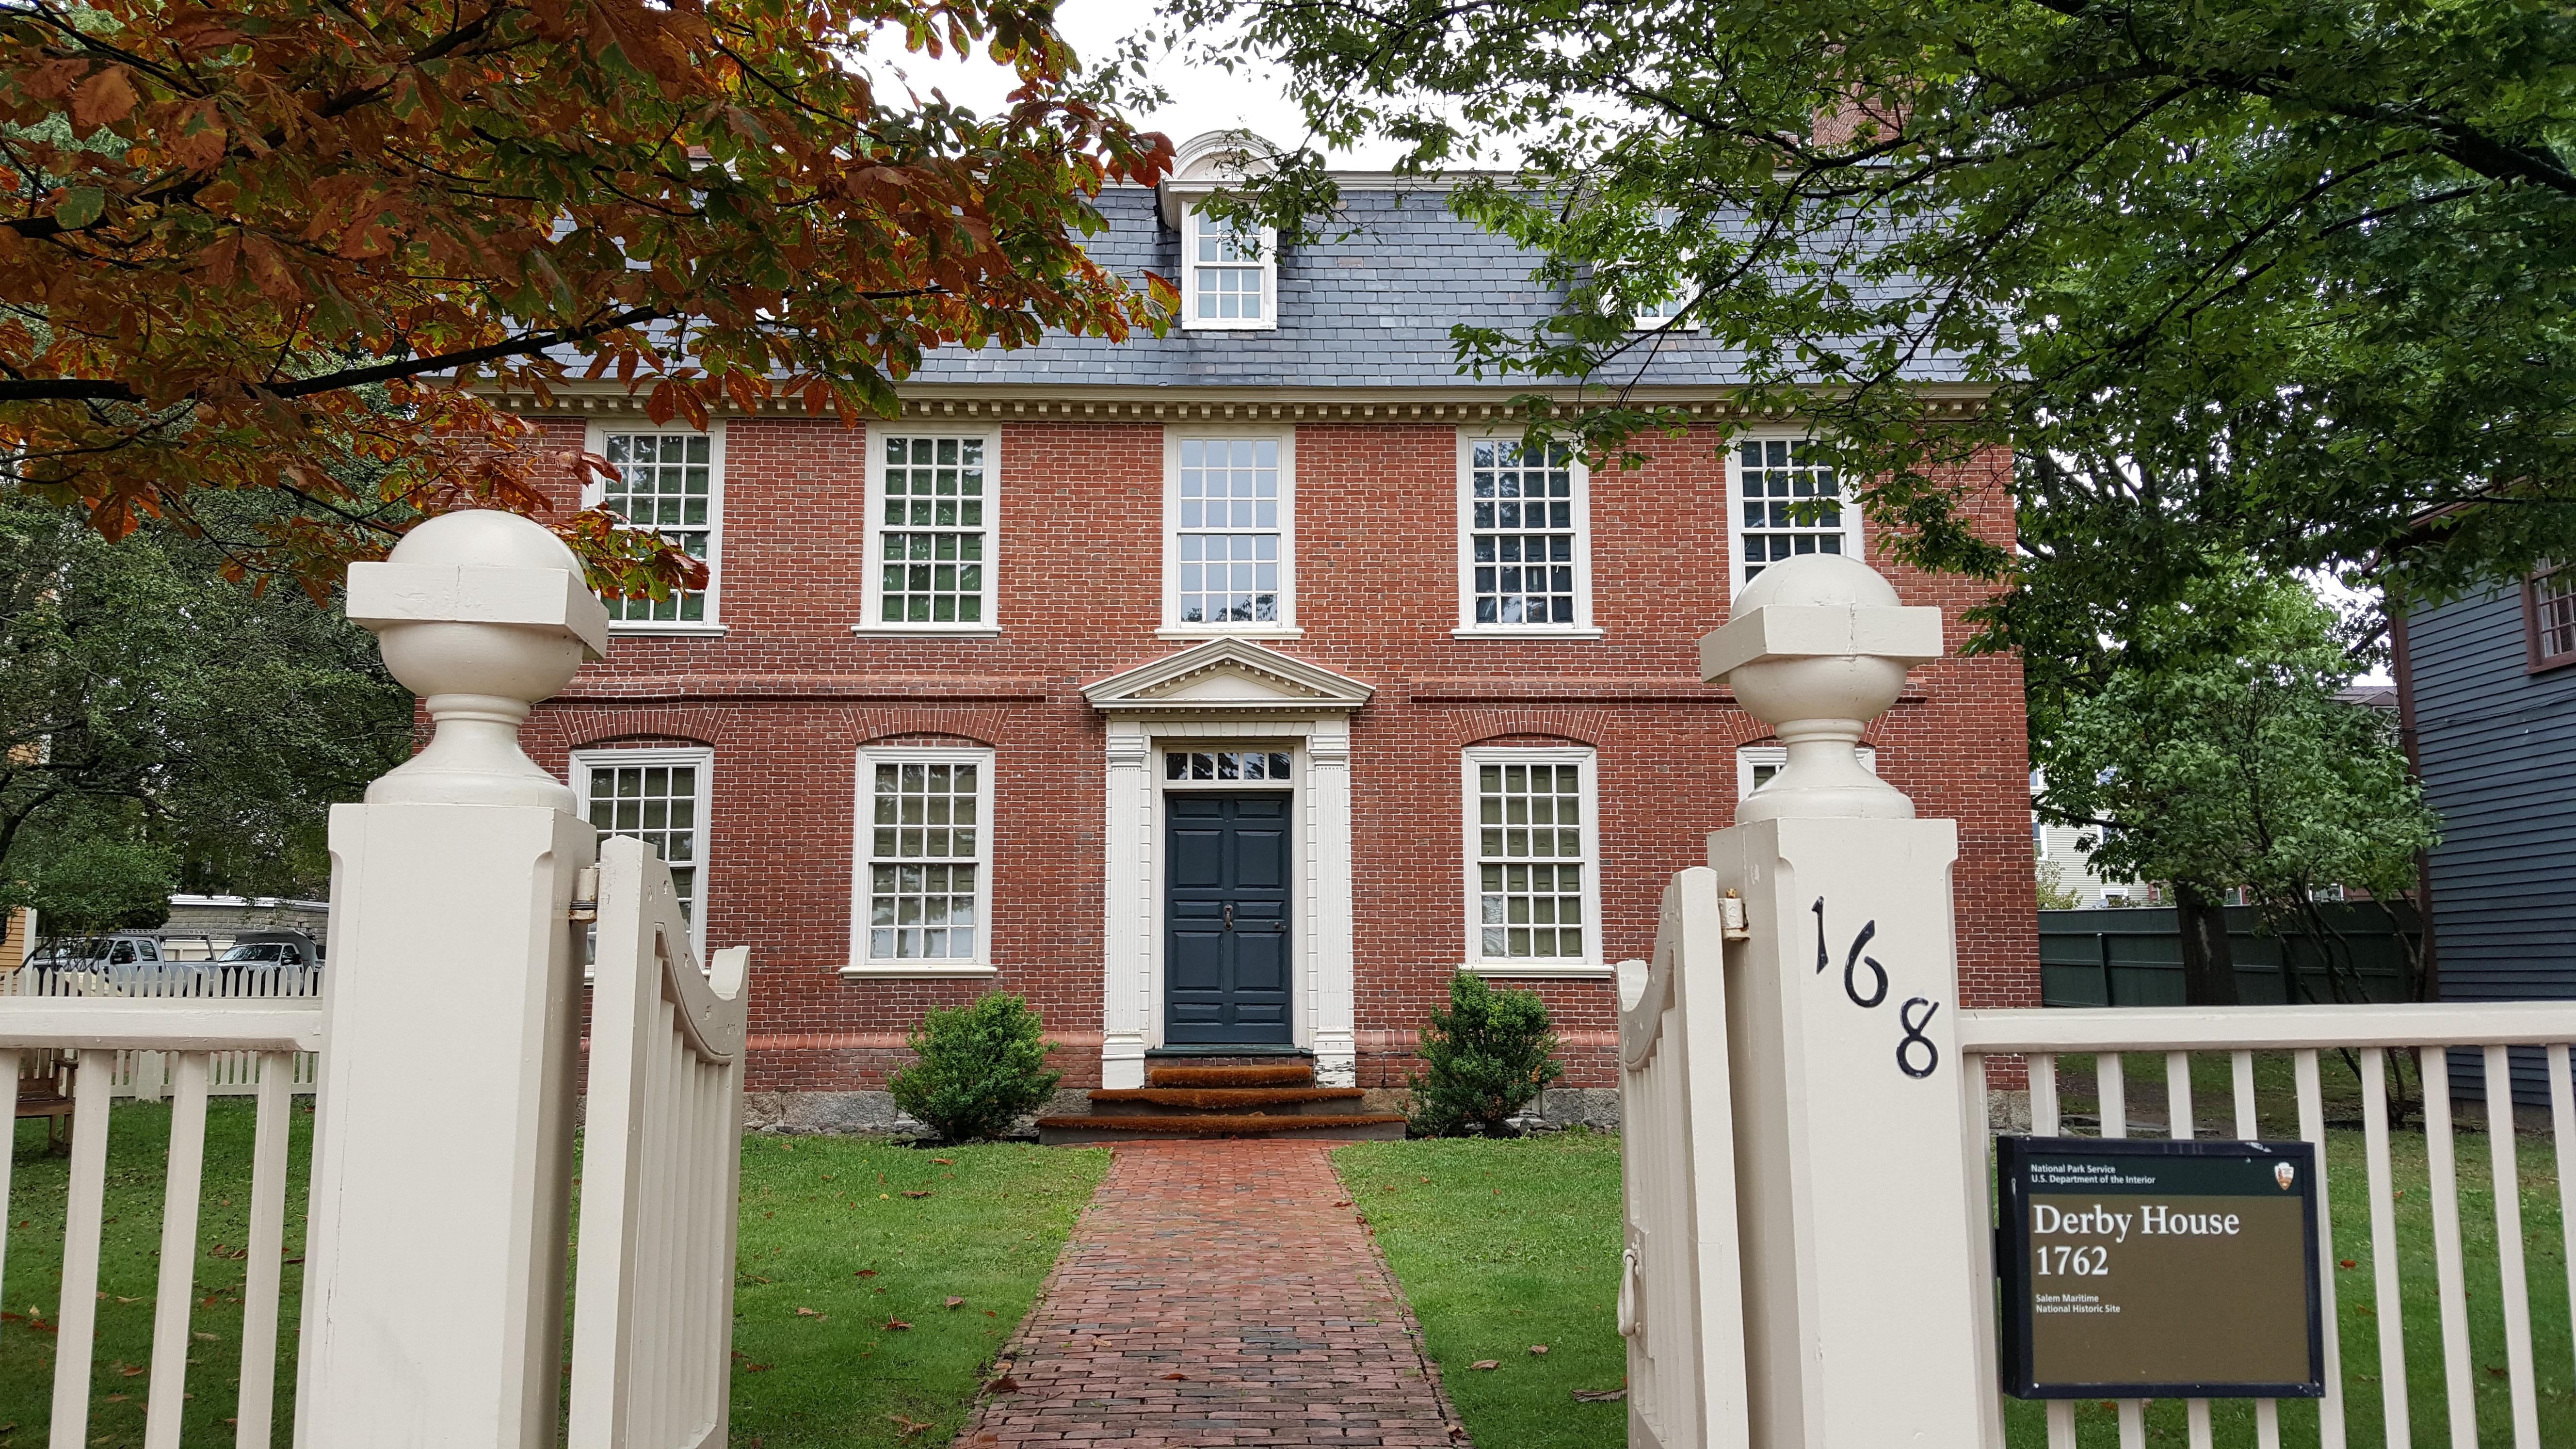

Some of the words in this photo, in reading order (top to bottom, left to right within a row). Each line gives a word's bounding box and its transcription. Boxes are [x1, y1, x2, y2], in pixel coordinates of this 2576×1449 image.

[1811, 896, 1939, 1079] 168
[2030, 1163, 2066, 1173] National
[2067, 1164, 2085, 1173] Park
[2087, 1164, 2116, 1174] Service
[2031, 1175, 2048, 1183] U.S.
[2049, 1175, 2098, 1185] Department
[2100, 1175, 2109, 1184] of
[2110, 1175, 2124, 1184] the
[2125, 1175, 2156, 1184] Interior
[2033, 1204, 2133, 1243] Derby
[2141, 1205, 2240, 1235] House
[2037, 1246, 2109, 1276] 1762
[2036, 1294, 2061, 1303] Salem
[2062, 1294, 2099, 1303] Maritime
[2036, 1304, 2071, 1313] National
[2073, 1304, 2103, 1313] Historic
[2105, 1304, 2121, 1313] Site
